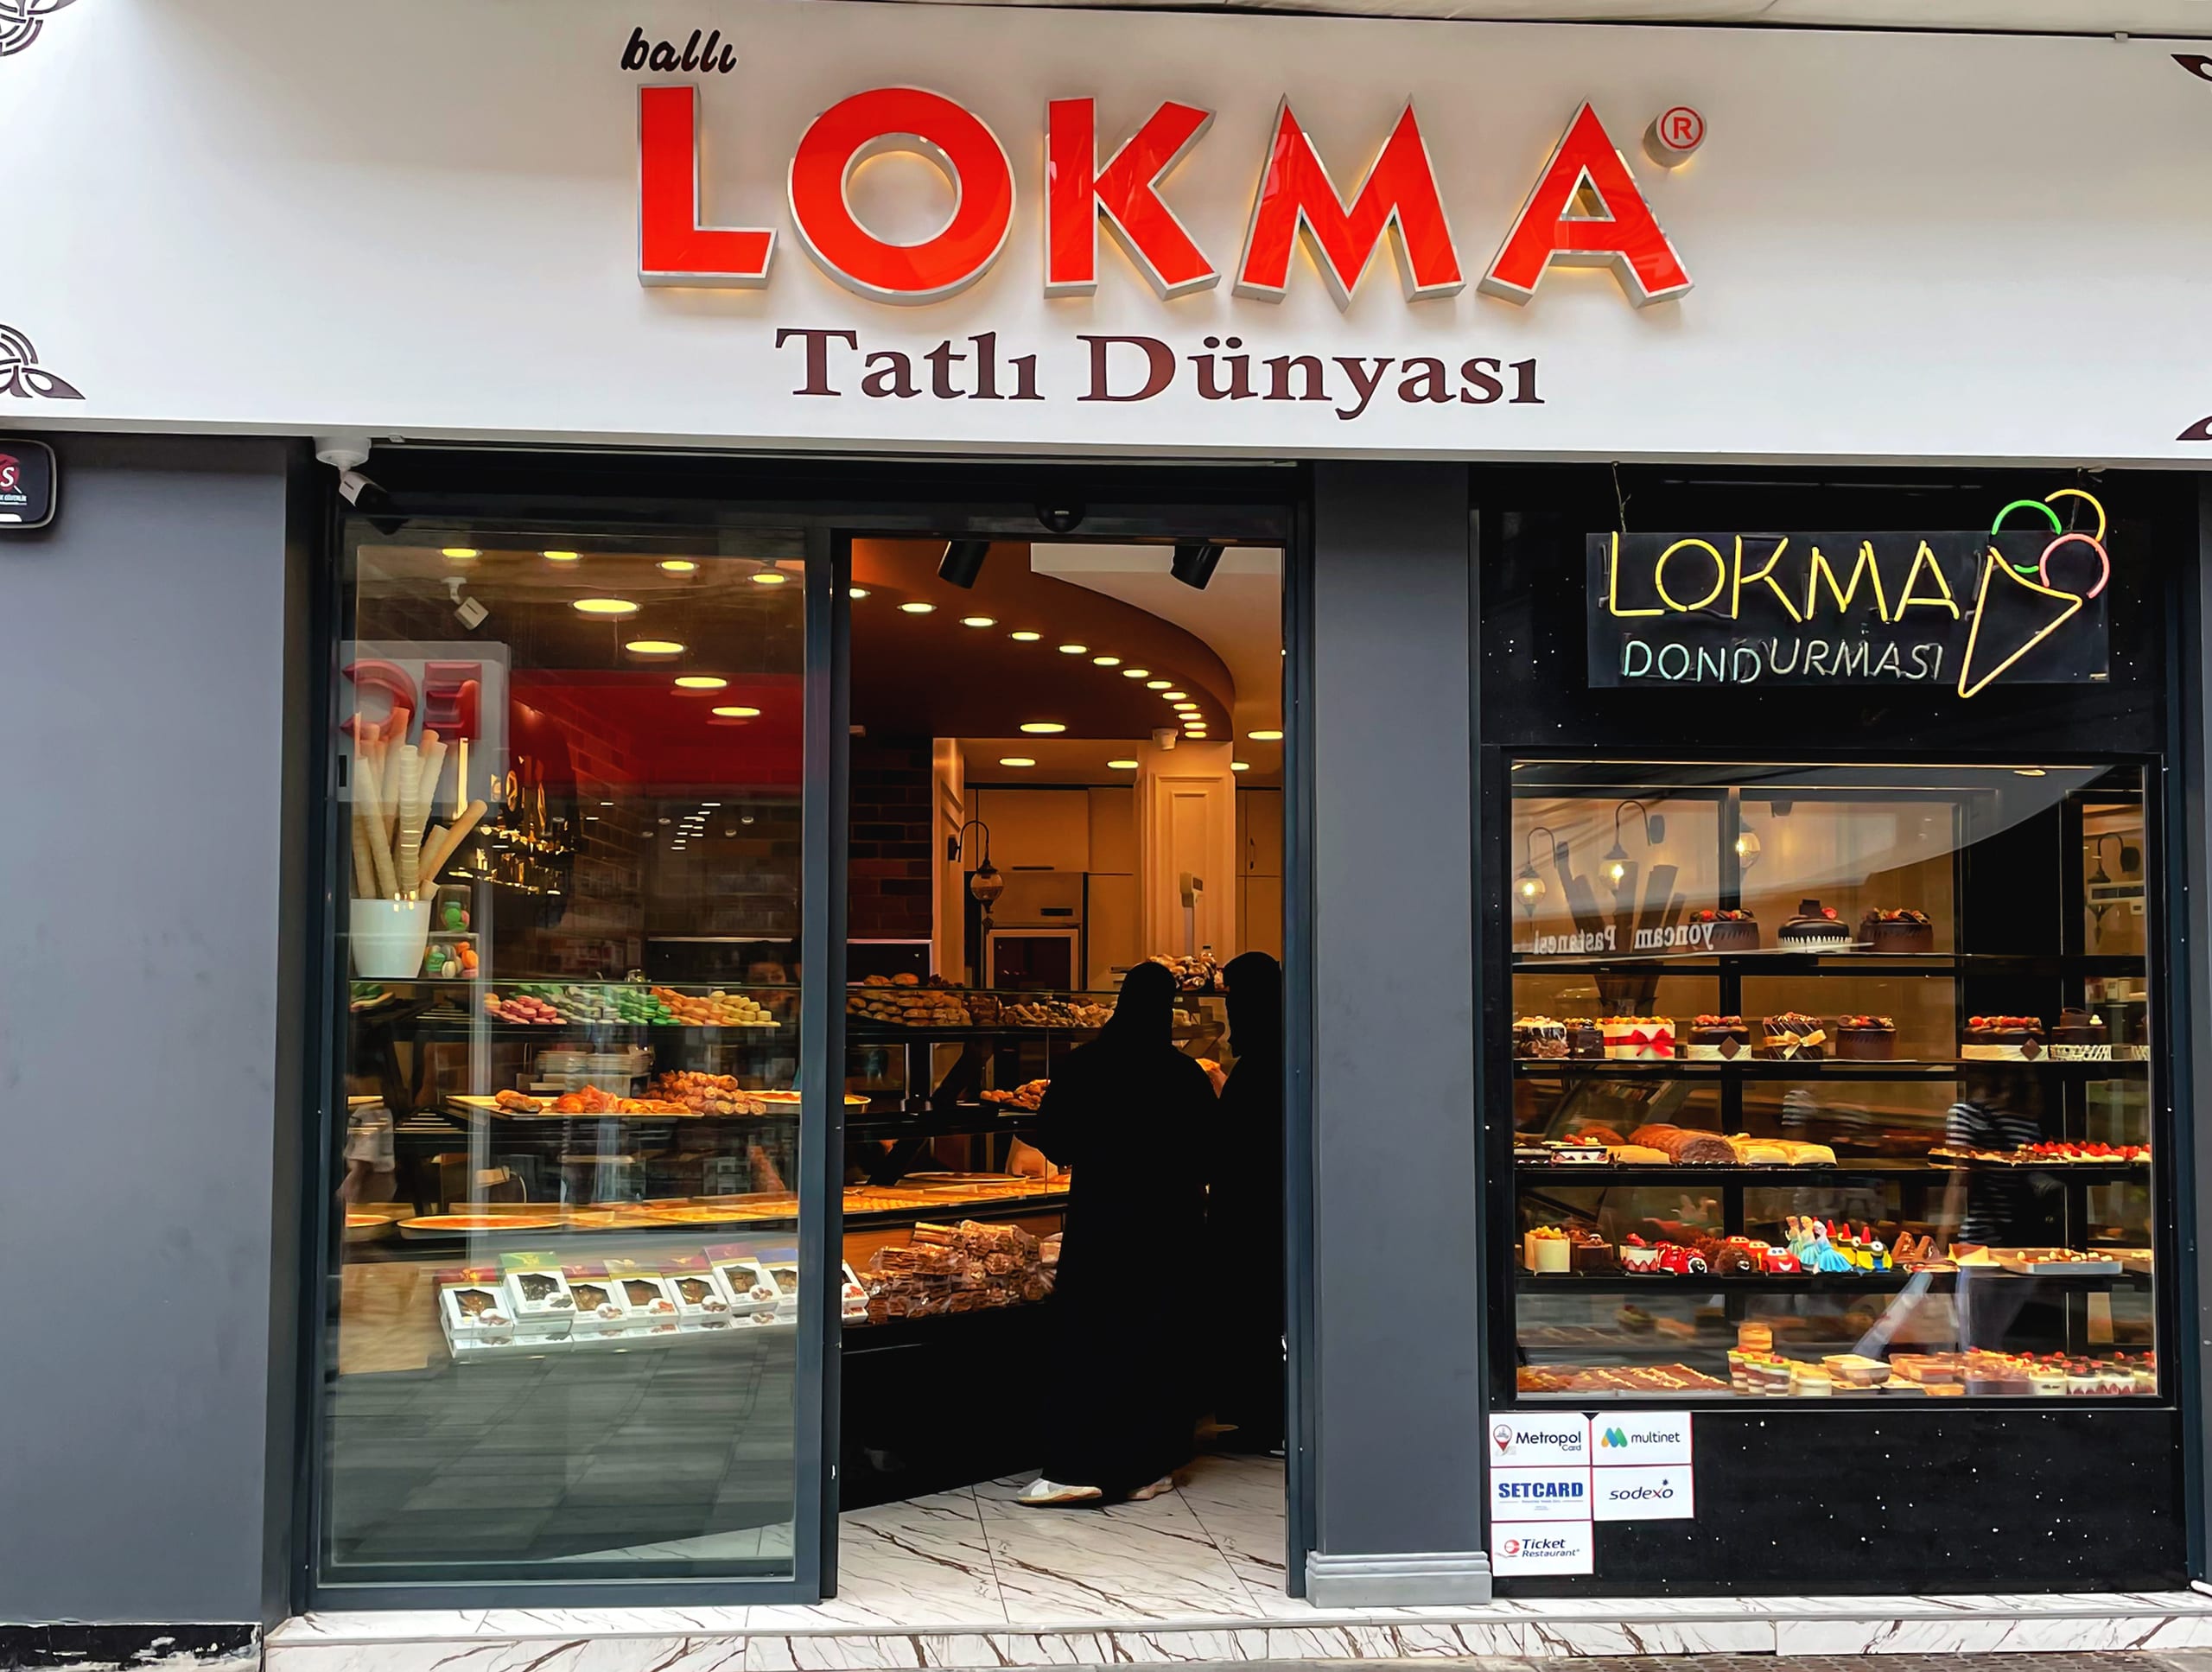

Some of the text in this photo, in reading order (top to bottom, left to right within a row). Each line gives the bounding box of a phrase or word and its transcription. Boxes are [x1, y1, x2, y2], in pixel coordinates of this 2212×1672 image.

[638, 83, 1697, 304] LOKMA
[775, 327, 1546, 422] Tatlı Dünyası
[1610, 531, 1961, 622] LOKMA
[1623, 637, 1944, 683] DONDURMASI
[1516, 1430, 1582, 1446] Metropol
[1630, 1431, 1681, 1444] multinet
[1497, 1482, 1584, 1498] SETCARD
[1609, 1484, 1674, 1500] sodexo
[1522, 1538, 1567, 1549] Ticket
